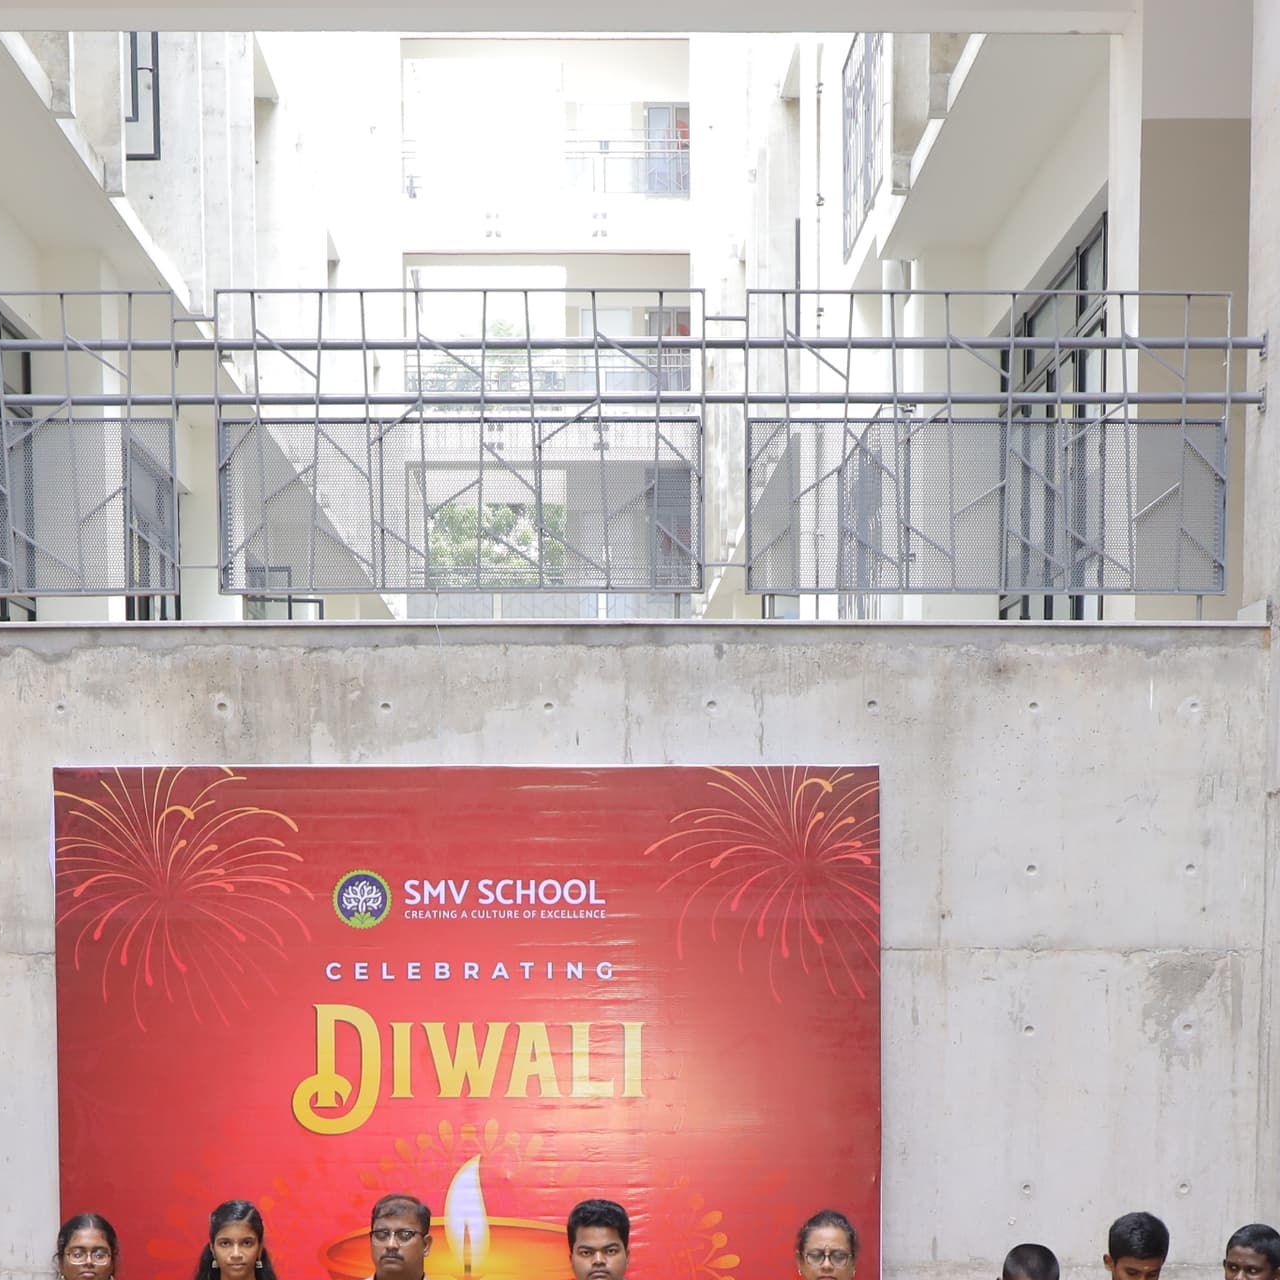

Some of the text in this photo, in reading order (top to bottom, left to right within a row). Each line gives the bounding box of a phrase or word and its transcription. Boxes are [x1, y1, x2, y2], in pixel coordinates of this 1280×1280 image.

[403, 879, 606, 905] SMV SCHOOL
[404, 910, 607, 919] CREATING A CULTURE OF EXCELLENCE
[325, 961, 614, 981] CELEBRATING
[292, 1003, 647, 1135] DIWALI
